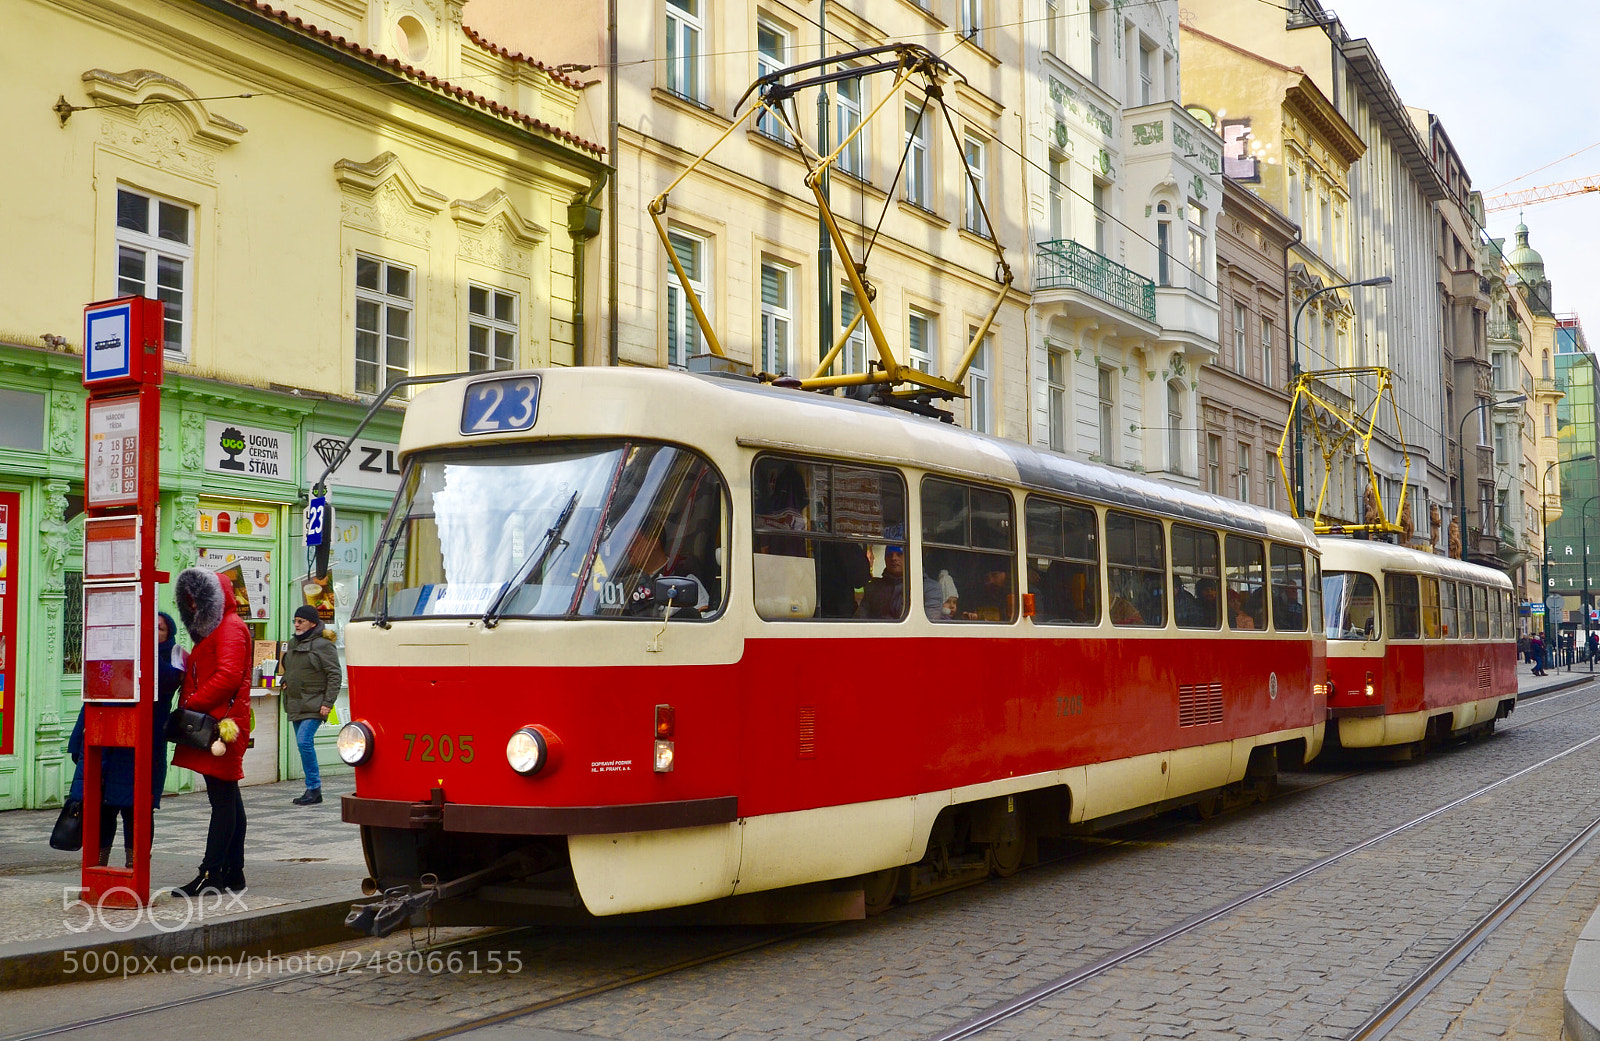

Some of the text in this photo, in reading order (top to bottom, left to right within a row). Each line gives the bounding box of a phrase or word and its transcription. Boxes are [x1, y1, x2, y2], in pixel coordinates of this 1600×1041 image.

[471, 380, 536, 430] 23
[97, 441, 104, 453] 2
[111, 440, 120, 451] 18
[125, 437, 135, 450] 93
[222, 438, 244, 450] UGO
[249, 434, 279, 449] UGOVA
[97, 455, 103, 467] 9
[110, 454, 120, 465] 22
[125, 452, 135, 464] 97
[110, 468, 120, 479] 23
[124, 466, 135, 478] 98
[249, 459, 279, 476] ŠŤÁVA
[110, 482, 119, 493] 41
[124, 480, 135, 492] 99
[308, 505, 324, 535] 23
[599, 581, 625, 605] 101
[1056, 695, 1083, 717] 7205
[403, 733, 475, 764] 7205
